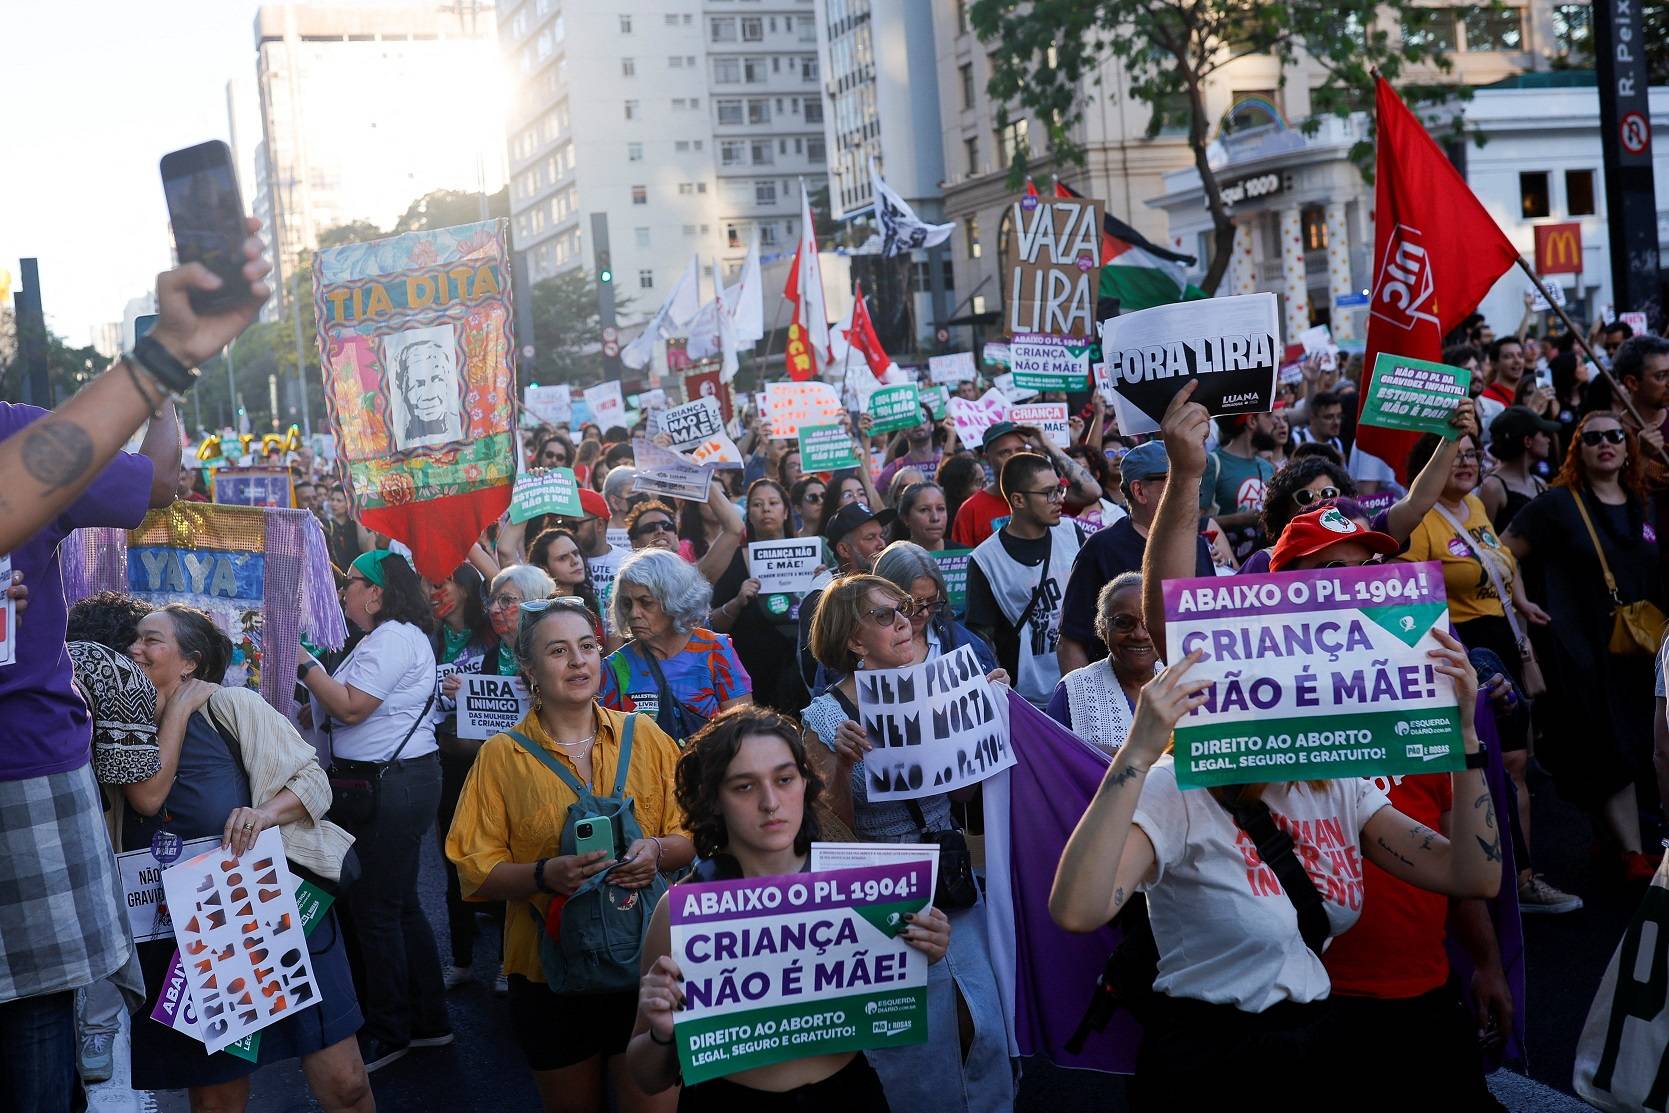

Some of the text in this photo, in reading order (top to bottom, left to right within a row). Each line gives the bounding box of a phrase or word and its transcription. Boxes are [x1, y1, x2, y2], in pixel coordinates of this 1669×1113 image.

[1618, 70, 1636, 97] R.
[1013, 201, 1100, 268] VAZA
[406, 264, 499, 310] DITA
[327, 283, 394, 323] TIA
[1011, 265, 1093, 337] LIRA
[1015, 347, 1066, 361] CRIANÇA
[1015, 359, 1082, 373] NÃO É MÃE!
[1108, 341, 1190, 388] FORA
[1194, 332, 1274, 375] LIRA
[1380, 374, 1425, 389] GRAVIDEZ
[1394, 367, 1415, 378] NÃO
[1415, 370, 1429, 380] AO
[1441, 374, 1455, 385] DA
[1222, 391, 1260, 404] LUANA
[1380, 401, 1410, 415] NÃO
[757, 545, 813, 560] CRIANÇA NÃO
[776, 558, 805, 570] MÃE!
[140, 551, 237, 597] YAYA
[592, 564, 611, 574] UTE
[1178, 573, 1430, 614] ABAIXO O PL 1904!
[1182, 619, 1375, 664] CRIANÇA
[468, 679, 516, 698] LIRA
[859, 671, 915, 705] NEM
[1189, 657, 1437, 717] NÃO É MÃE!
[470, 698, 517, 712] INIMIGO
[483, 712, 519, 721] MULHERES
[477, 719, 516, 730] CRIANÇAS
[866, 706, 922, 748] NEM
[1410, 718, 1451, 728] ESQUERDA
[1190, 729, 1373, 757] DIREITO AO ABORTO
[1190, 747, 1387, 773] LEGAL, SEGURO E GRATUITO!
[138, 867, 161, 885] NÃO
[682, 871, 917, 918] ABAIXO O PL 1904!
[684, 917, 859, 965] CRIANÇA
[684, 949, 908, 1012] NÃO É MÃE!
[689, 1011, 846, 1051] DIREITO AO ABORTO
[691, 1025, 856, 1067] LEGAL, SEGURO E GRATUITO!
